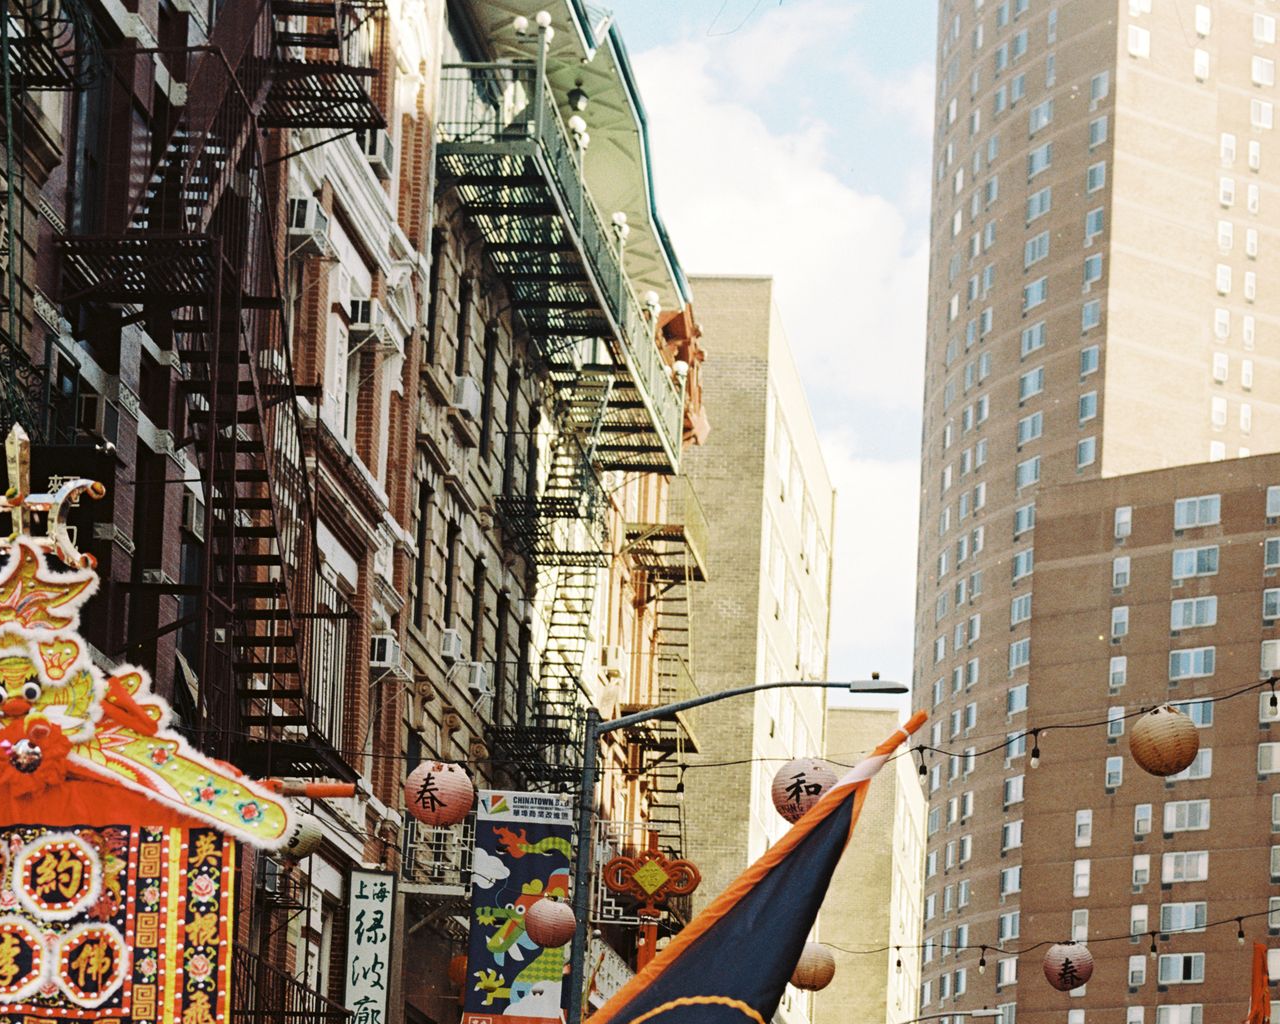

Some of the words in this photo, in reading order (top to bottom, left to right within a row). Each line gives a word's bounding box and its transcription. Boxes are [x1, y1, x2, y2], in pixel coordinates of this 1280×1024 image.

[415, 772, 447, 812] 春
[513, 796, 554, 806] CHINATOWN
[785, 772, 823, 808] 和
[1057, 957, 1082, 985] 春
